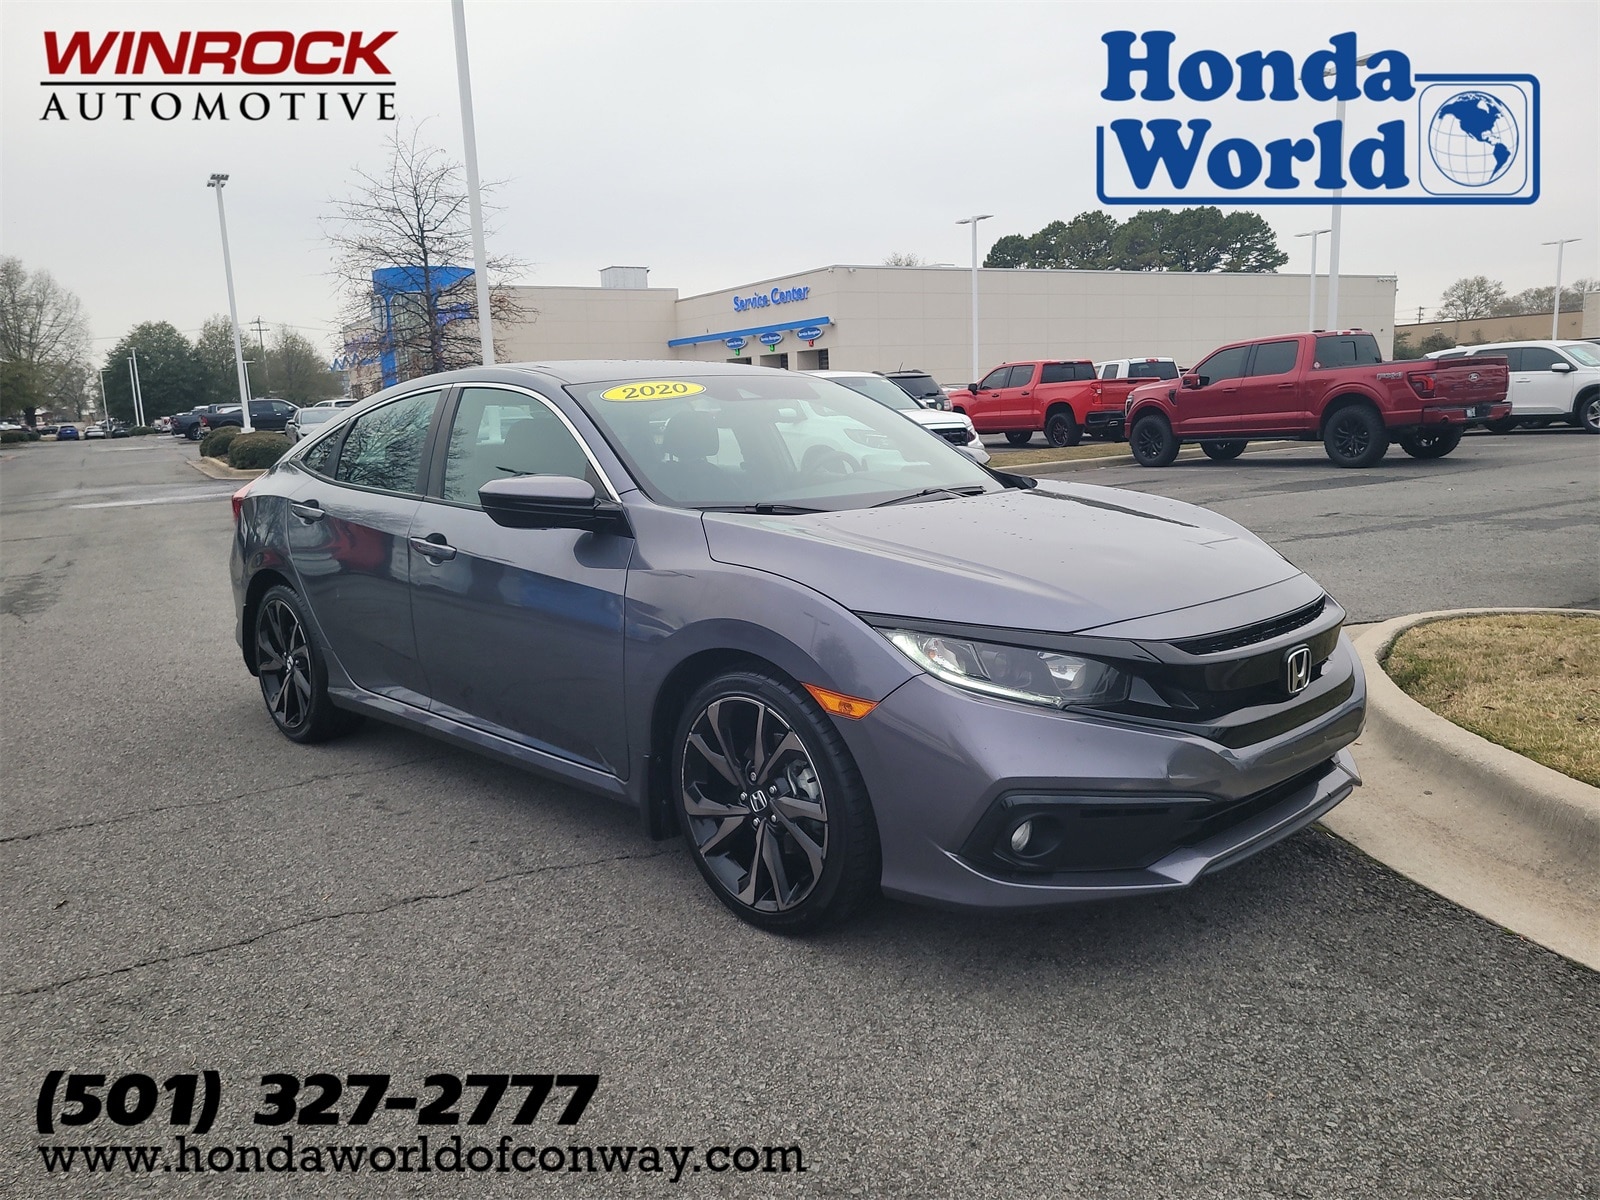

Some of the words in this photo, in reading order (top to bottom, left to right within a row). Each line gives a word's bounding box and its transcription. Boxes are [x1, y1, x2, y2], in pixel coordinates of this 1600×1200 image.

[733, 292, 770, 312] Service
[770, 287, 810, 305] Center
[622, 383, 688, 400] 2020
